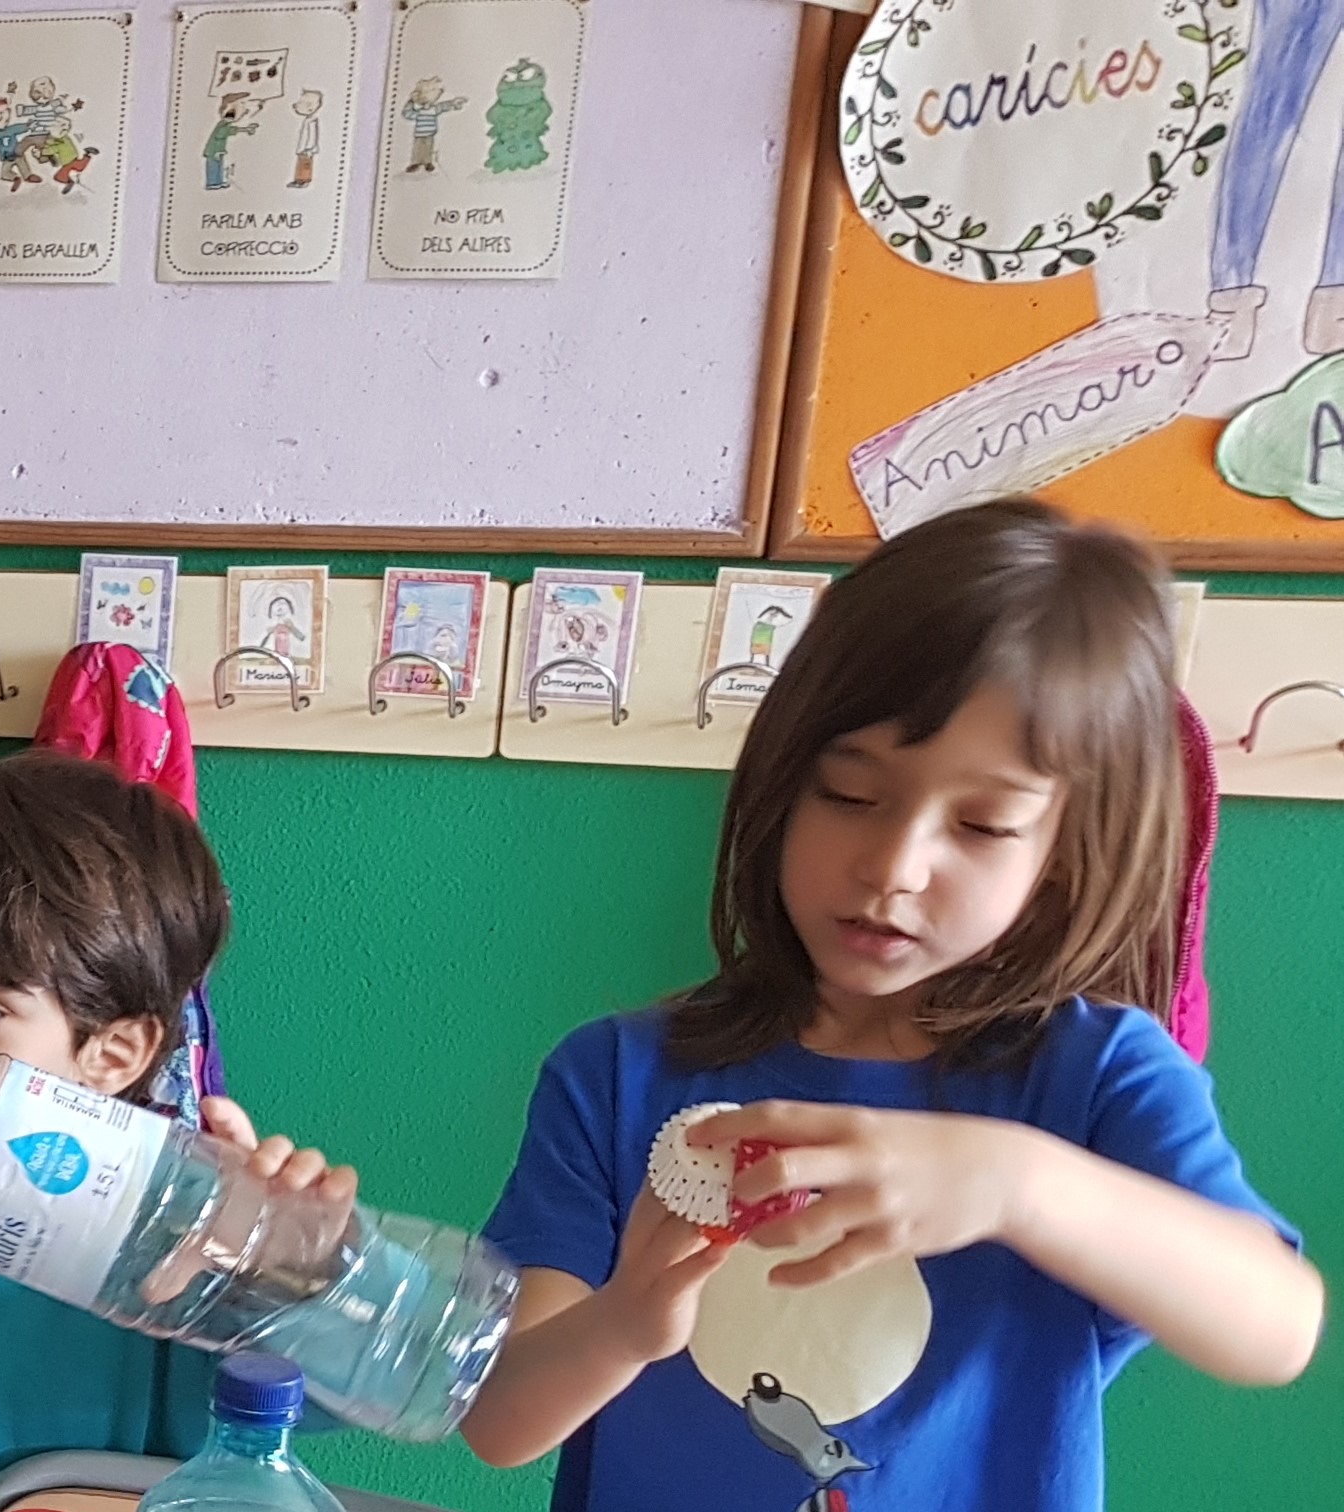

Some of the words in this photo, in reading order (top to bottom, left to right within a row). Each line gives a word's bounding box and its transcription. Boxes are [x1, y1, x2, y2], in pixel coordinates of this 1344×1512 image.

[202, 213, 257, 229] PARLEM
[263, 213, 302, 228] AMB
[434, 208, 460, 223] NO
[22, 243, 99, 258] BARALLEM
[201, 240, 299, 256] CORRECCIÓ
[421, 236, 453, 253] DELS
